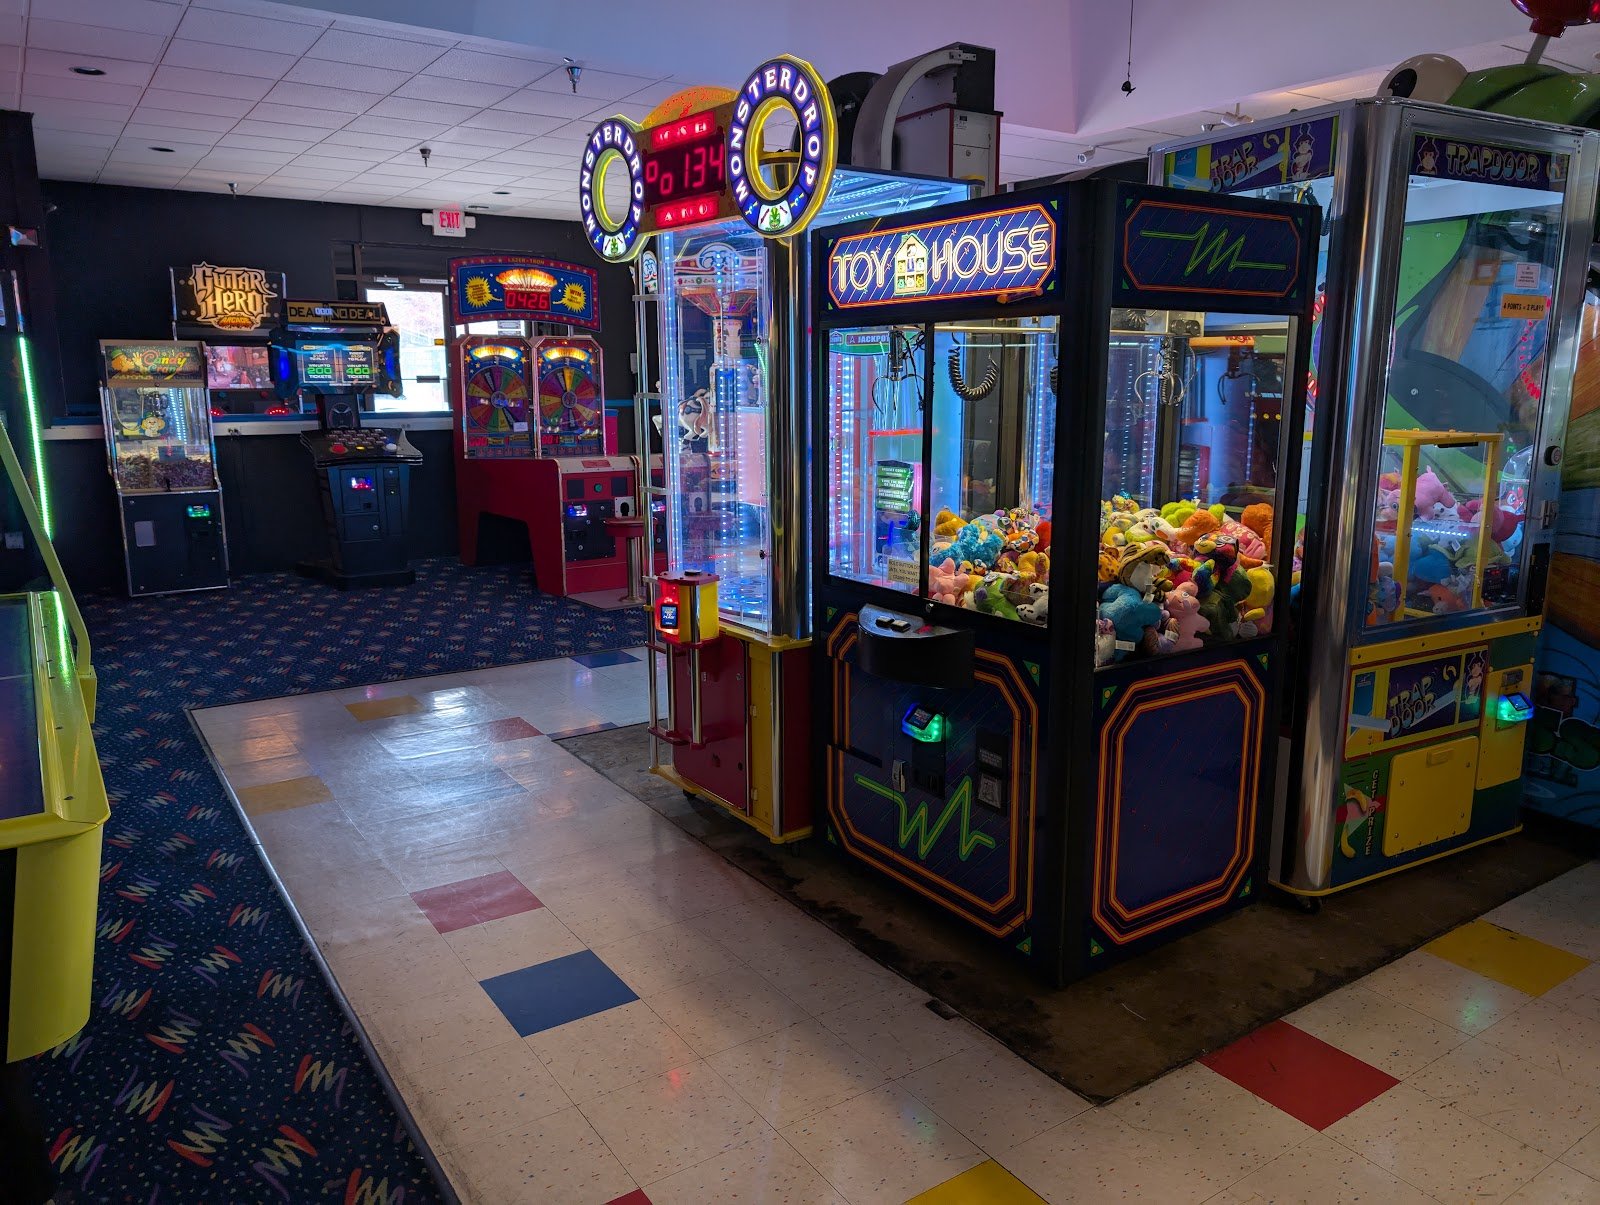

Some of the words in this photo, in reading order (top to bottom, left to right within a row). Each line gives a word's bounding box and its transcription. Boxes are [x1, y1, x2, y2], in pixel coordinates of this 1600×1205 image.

[1210, 155, 1259, 193] DOOR
[1211, 140, 1255, 178] TRAP
[439, 211, 460, 229] EXIT
[833, 248, 892, 293] TOY
[932, 223, 1050, 283] HOUSE
[195, 266, 267, 300] GUITAR
[506, 291, 549, 309] 0426
[331, 309, 347, 319] NO
[142, 350, 187, 368] Candy
[346, 367, 370, 375] 400
[1389, 675, 1433, 716] TRAP
[1389, 692, 1437, 739] DOOR
[1371, 769, 1380, 800] GET
[1364, 805, 1376, 856] PRIZE
